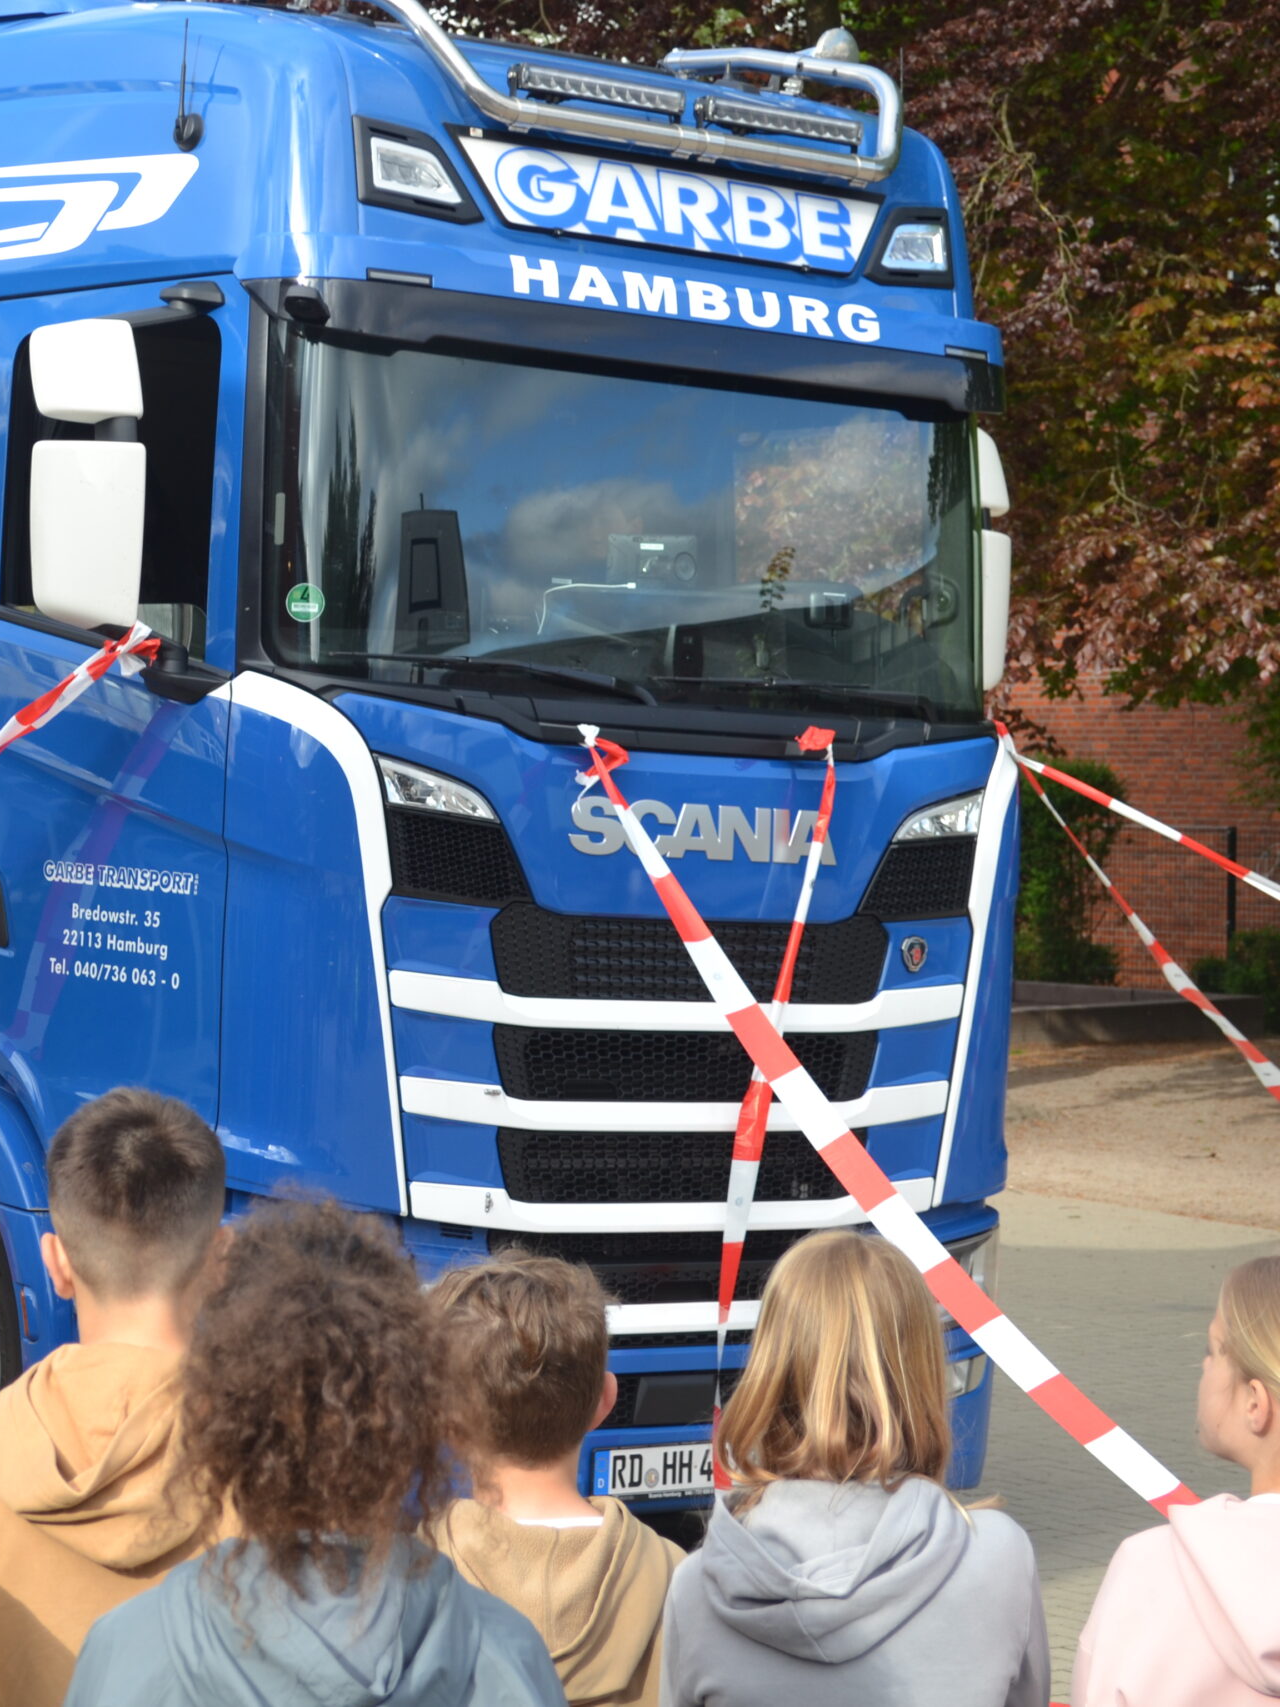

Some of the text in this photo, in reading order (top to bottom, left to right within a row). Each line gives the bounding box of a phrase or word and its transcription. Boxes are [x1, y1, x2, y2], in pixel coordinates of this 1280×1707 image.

[495, 146, 853, 268] GARBE
[509, 255, 881, 342] HAMBURG
[568, 796, 837, 866] SCANIA
[43, 859, 94, 885] GARBE
[97, 864, 194, 895] TRANSPORT
[71, 902, 161, 928] Bredowstr. 35
[62, 929, 168, 961] 22113 Hamburg
[49, 957, 70, 976] Tel.
[74, 960, 128, 983] 040/736
[131, 968, 156, 986] 063
[171, 972, 180, 989] 0
[611, 1454, 643, 1489] RD
[662, 1450, 693, 1485] HH
